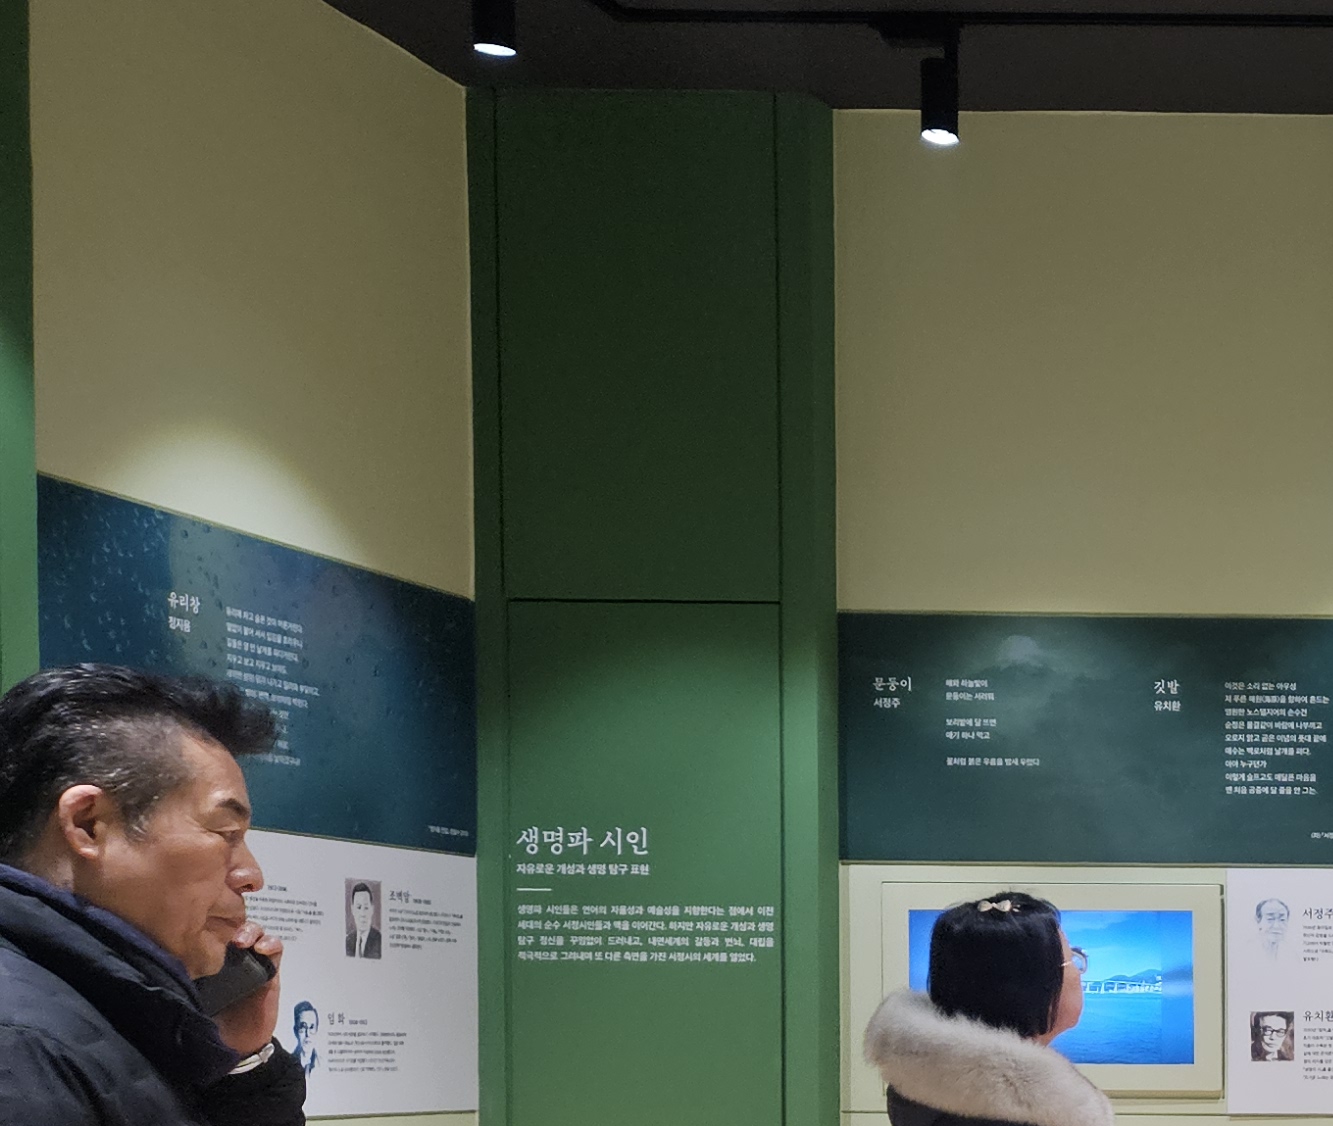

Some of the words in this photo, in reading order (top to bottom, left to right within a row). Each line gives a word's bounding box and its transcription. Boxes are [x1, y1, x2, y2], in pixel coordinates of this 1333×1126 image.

[168, 591, 201, 615] 유리창
[873, 676, 912, 692] 문둥이
[1154, 679, 1180, 695] 깃발
[873, 697, 901, 709] 서정주
[1154, 700, 1181, 712] 유치환
[517, 826, 592, 855] 생명파
[600, 826, 648, 856] 시인
[516, 863, 555, 875] 자유로운
[556, 863, 586, 875] 개성과
[587, 863, 607, 876] 생명
[608, 863, 629, 876] 탐구
[630, 863, 650, 876] 표현
